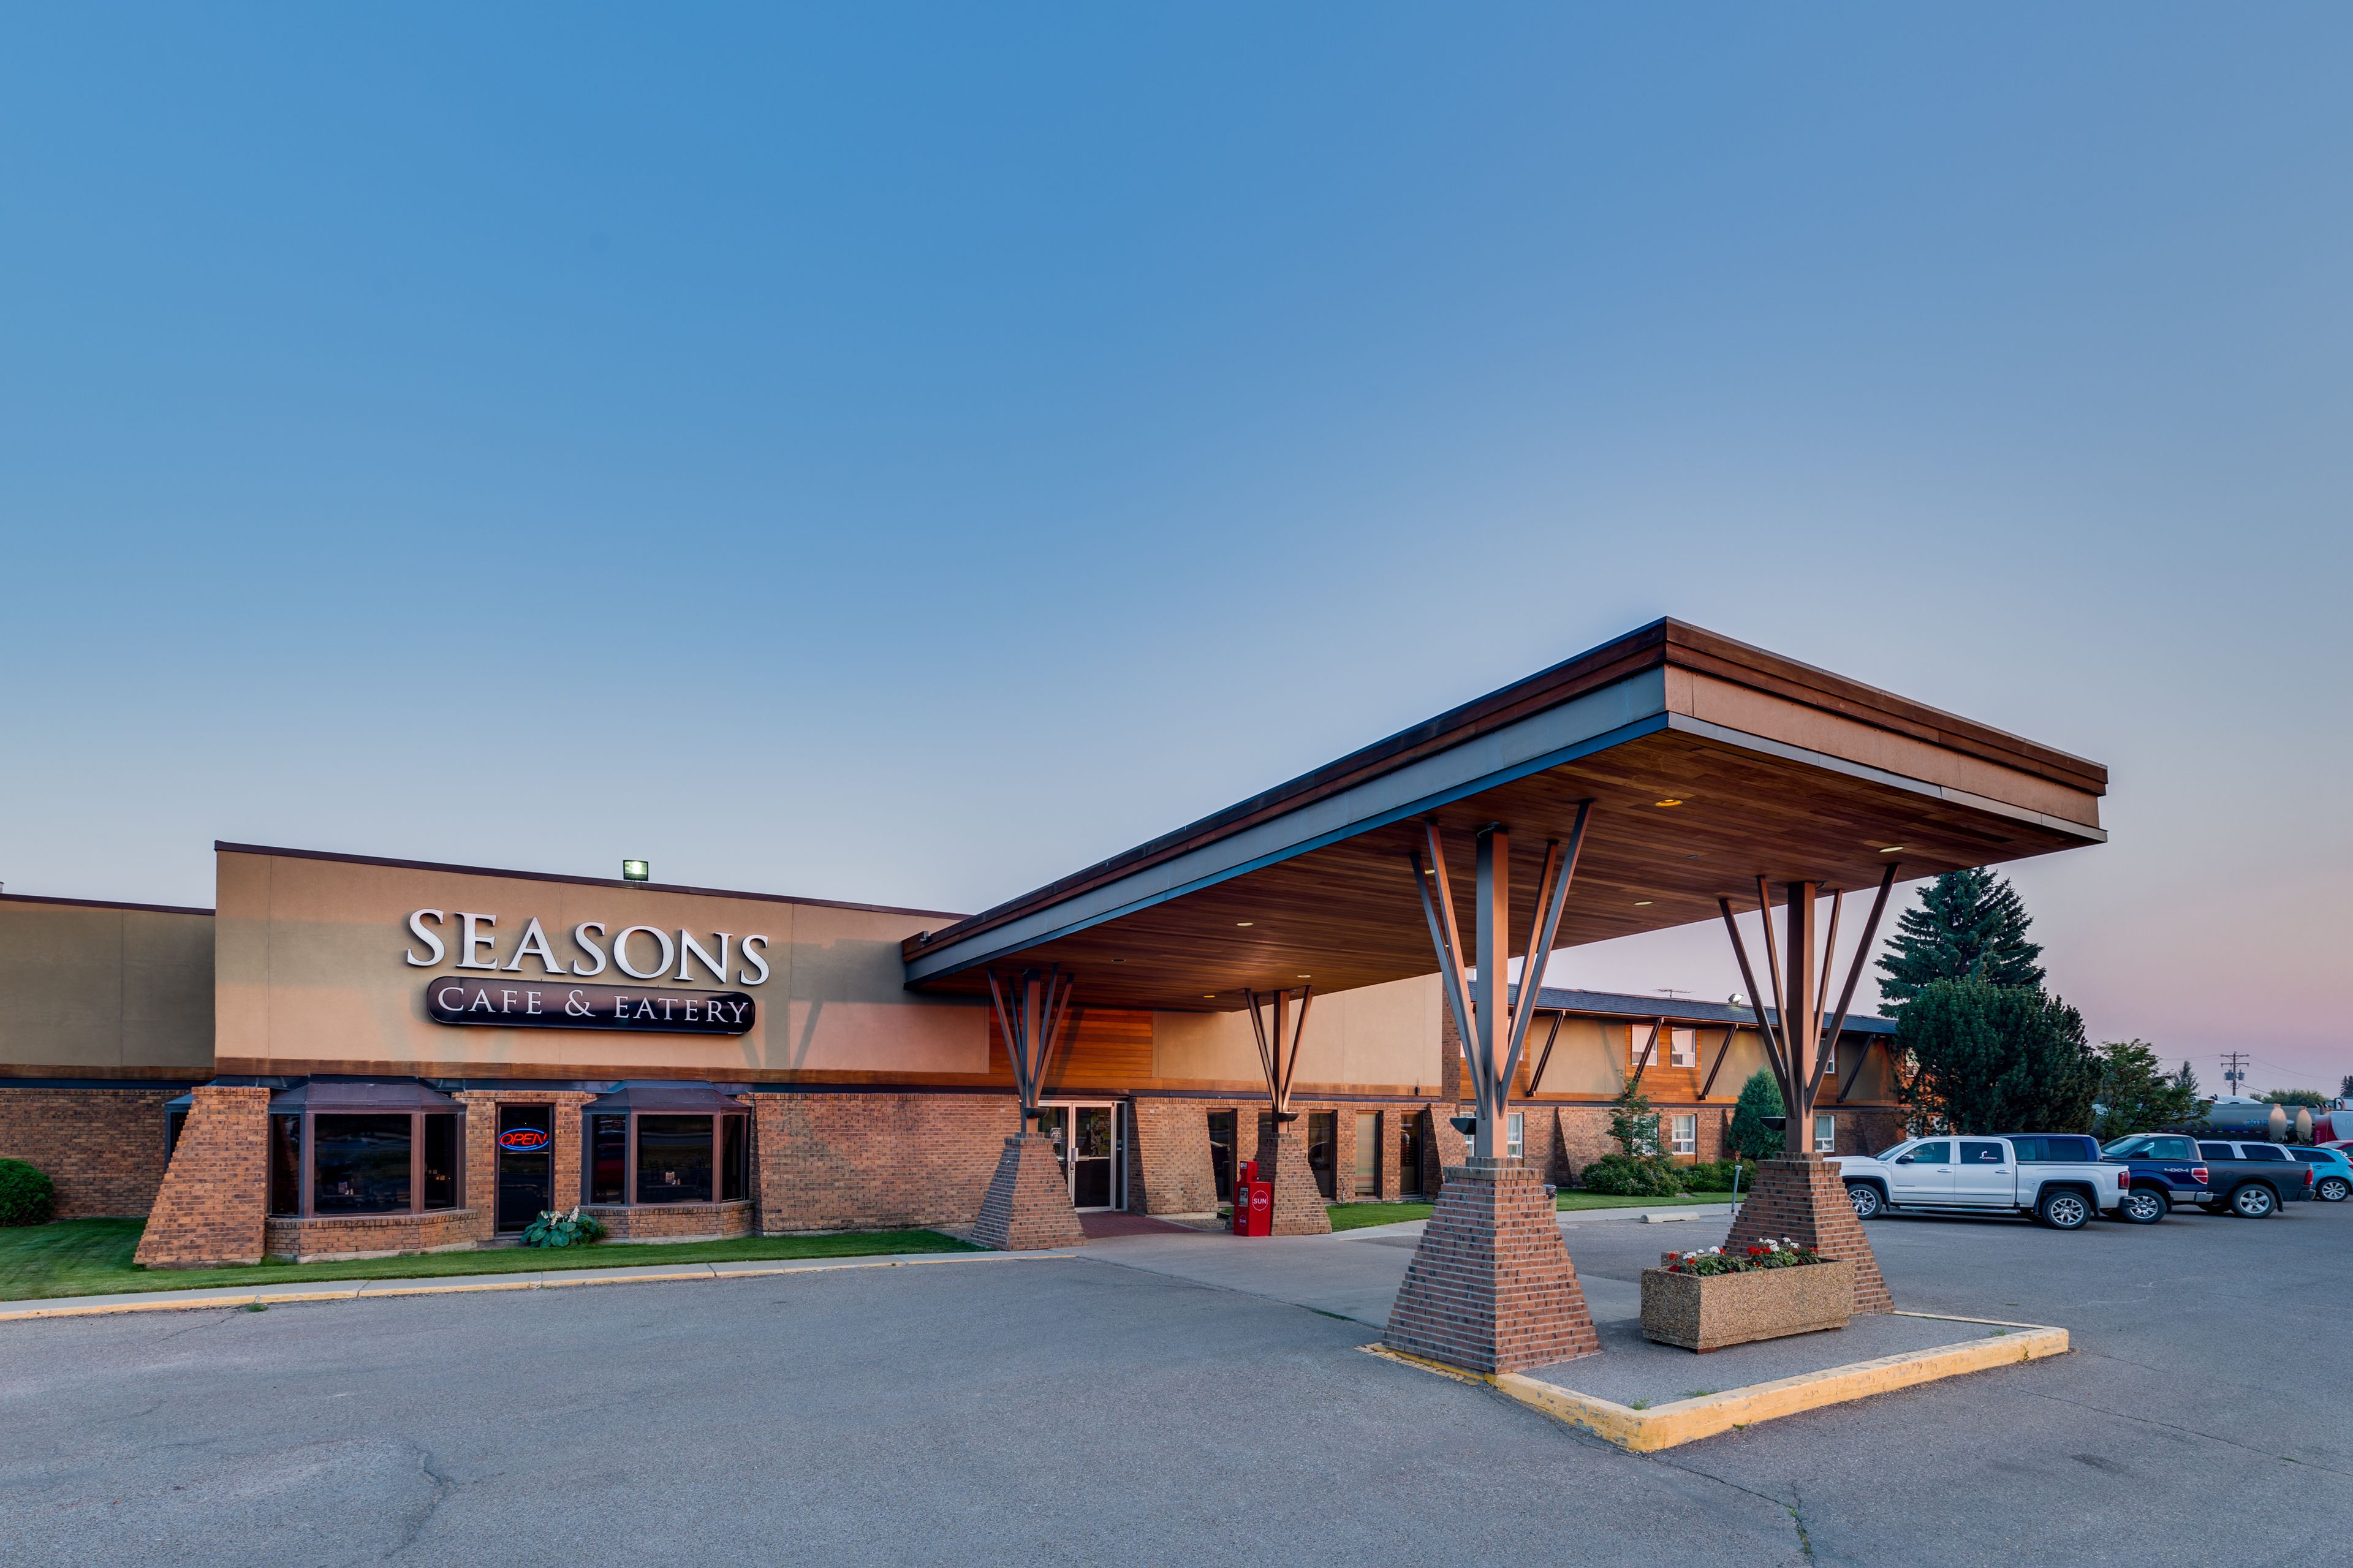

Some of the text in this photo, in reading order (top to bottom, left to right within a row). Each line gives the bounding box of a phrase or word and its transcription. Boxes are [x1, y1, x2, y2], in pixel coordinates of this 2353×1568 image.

[407, 908, 770, 985] SEASONS
[438, 987, 749, 1024] CAFE & EATERY
[500, 1133, 547, 1145] OPEN
